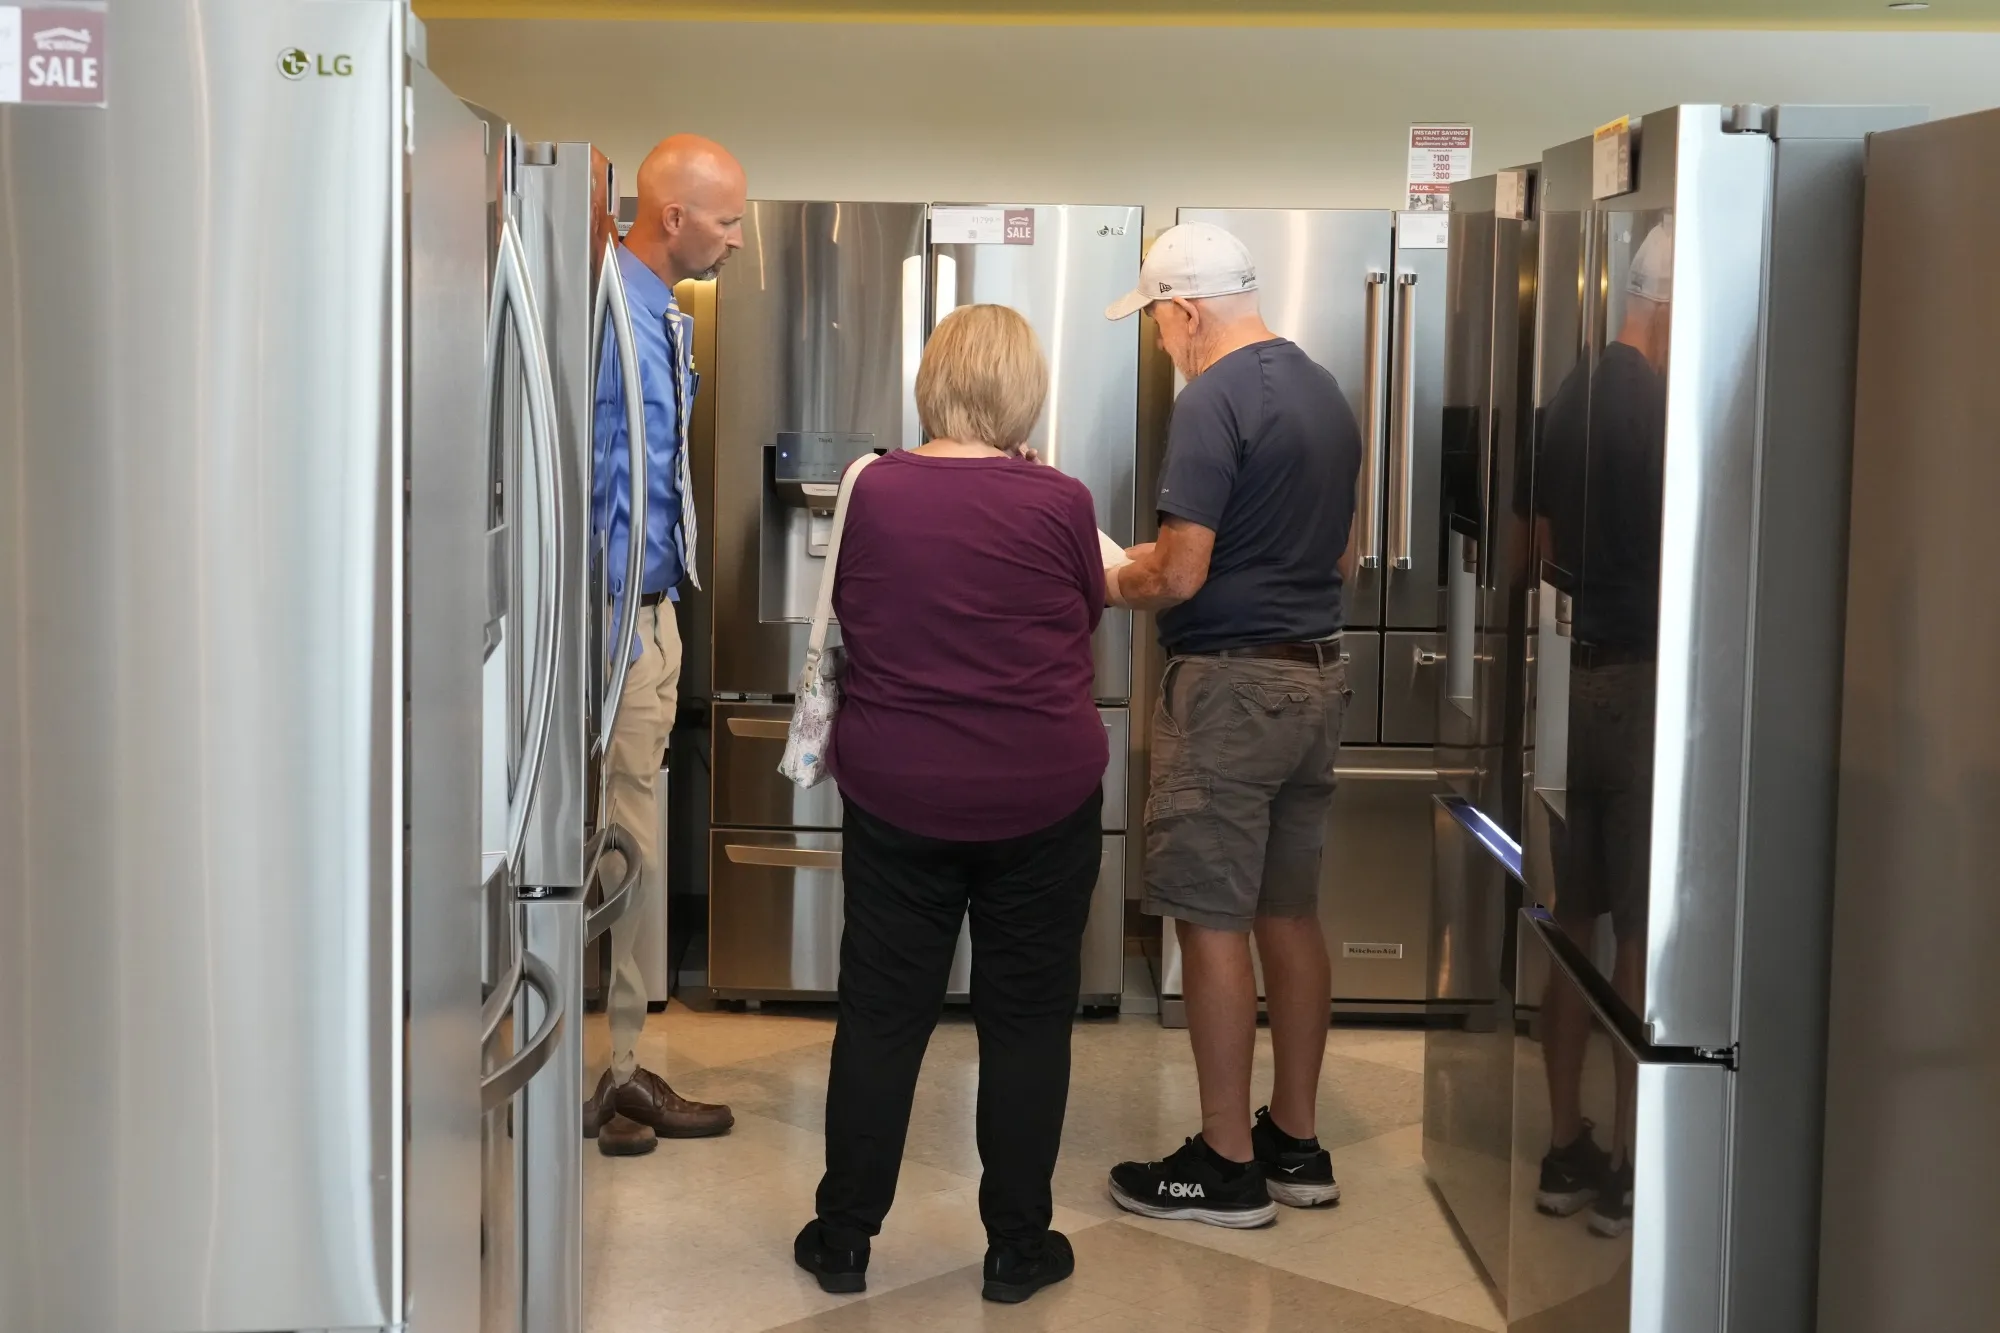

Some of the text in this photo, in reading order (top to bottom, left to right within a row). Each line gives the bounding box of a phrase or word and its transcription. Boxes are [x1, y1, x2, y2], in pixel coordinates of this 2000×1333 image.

[316, 53, 353, 76] LG
[28, 55, 98, 88] SALE
[1433, 154, 1450, 162] $100
[1432, 163, 1450, 171] $200
[1432, 171, 1450, 180] $300
[1006, 226, 1032, 239] SALE
[1157, 1181, 1205, 1198] HOKA
